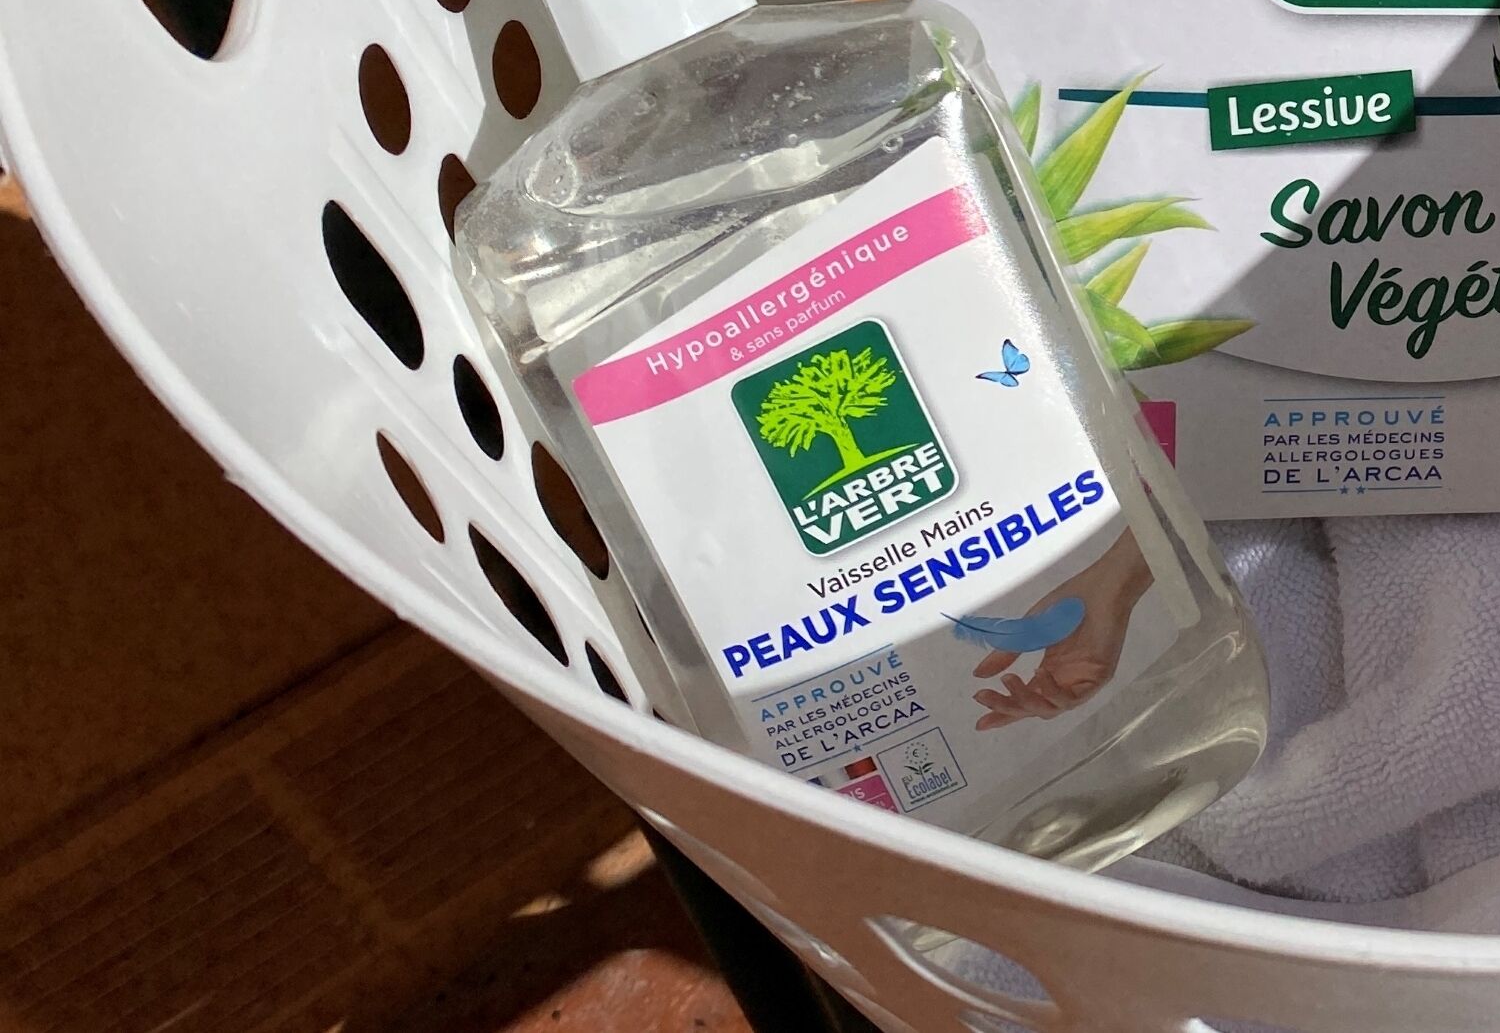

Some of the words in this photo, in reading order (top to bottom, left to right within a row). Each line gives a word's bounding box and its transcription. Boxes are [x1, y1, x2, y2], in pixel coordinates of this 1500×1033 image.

[1228, 86, 1392, 136] Lessive
[1260, 178, 1495, 249] Savon
[646, 223, 910, 375] Hypoallergénique
[746, 325, 784, 355] sans
[787, 287, 847, 333] parfum
[1264, 406, 1444, 427] APPROUVÉ
[1264, 435, 1300, 446] PAR
[1308, 434, 1340, 445] LES
[1348, 430, 1445, 444] MÉDECINS
[794, 441, 940, 527] L'ARBRE
[1264, 449, 1443, 463] ALLERGOLOGUES
[1264, 469, 1300, 484] DE
[1317, 466, 1442, 483] L'ARCAA
[802, 462, 945, 546] VERT
[722, 595, 871, 678] PEAUX
[873, 470, 1105, 615] SENSIBLES
[807, 540, 917, 598] Vaisselle
[920, 499, 995, 548] Mains
[761, 651, 903, 722] APPROUVÉ
[767, 720, 796, 737] PAR
[799, 708, 827, 724] LES
[831, 672, 910, 713] MÉDECINS
[775, 685, 917, 750] ALLERGOLOGUES
[781, 746, 813, 767] DE
[820, 701, 925, 752] L'ARCAA
[903, 766, 952, 799] Ecolabel
